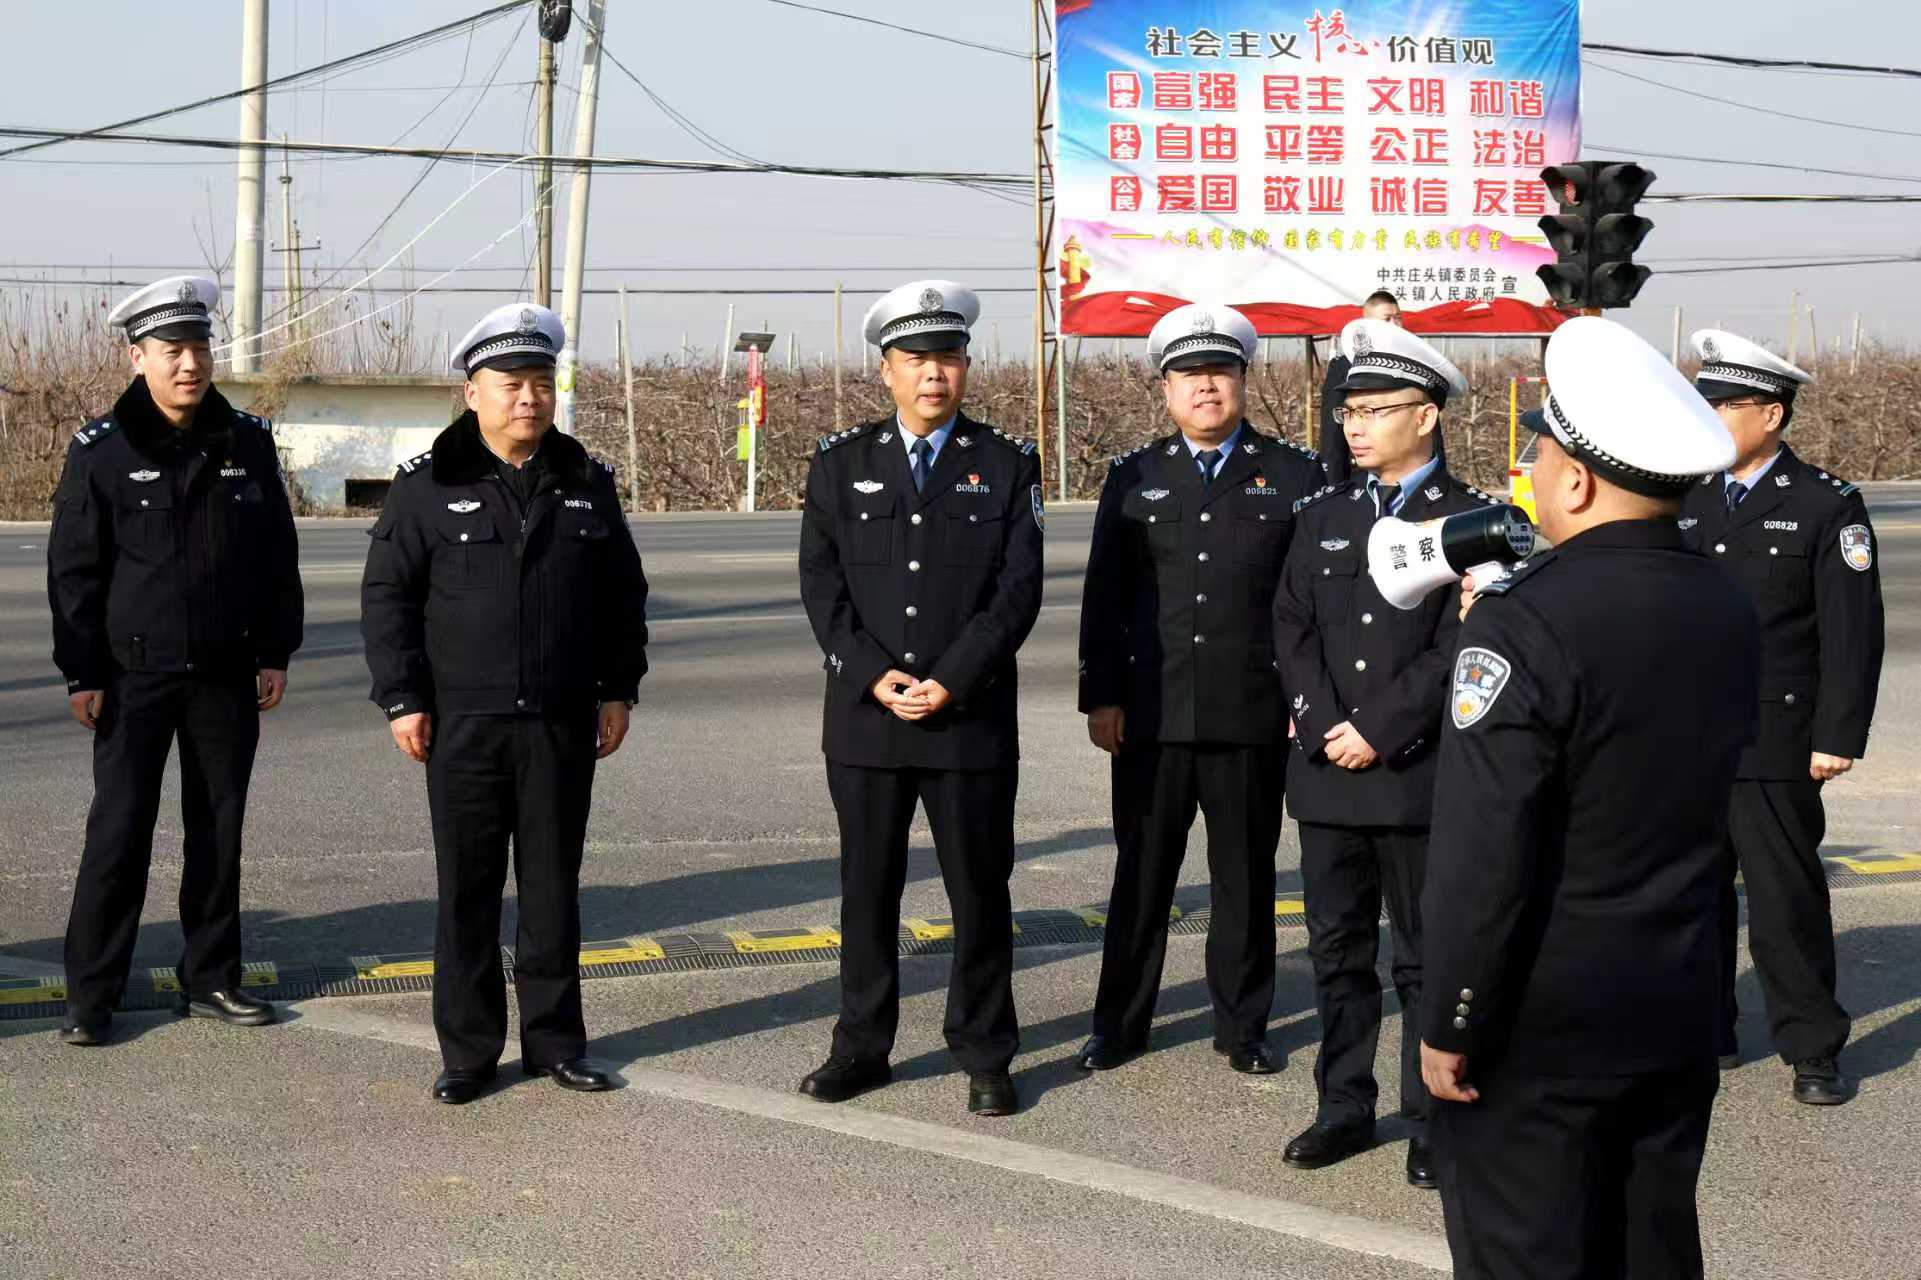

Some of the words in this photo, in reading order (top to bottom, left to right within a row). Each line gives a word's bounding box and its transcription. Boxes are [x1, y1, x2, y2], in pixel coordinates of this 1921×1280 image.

[1147, 9, 1494, 64] 社会主义核心价值观
[1153, 72, 1238, 111] 富强
[1263, 74, 1345, 114] 民主
[1366, 76, 1447, 116] 文明
[1469, 80, 1545, 119] 和谐
[1155, 123, 1238, 162] 自由
[1264, 124, 1345, 164] 平等
[1370, 126, 1449, 165] 公正
[1473, 129, 1547, 167] 法治
[1156, 174, 1238, 214] 爱国
[1264, 175, 1345, 215] 敬业
[1370, 176, 1449, 216] 诚信
[1472, 178, 1547, 217] 友善
[1376, 266, 1498, 283] 中共庄头镇委员会
[1377, 286, 1497, 302] 头镇人民政府
[1501, 275, 1518, 294] 宣
[1390, 536, 1436, 571] 警察
